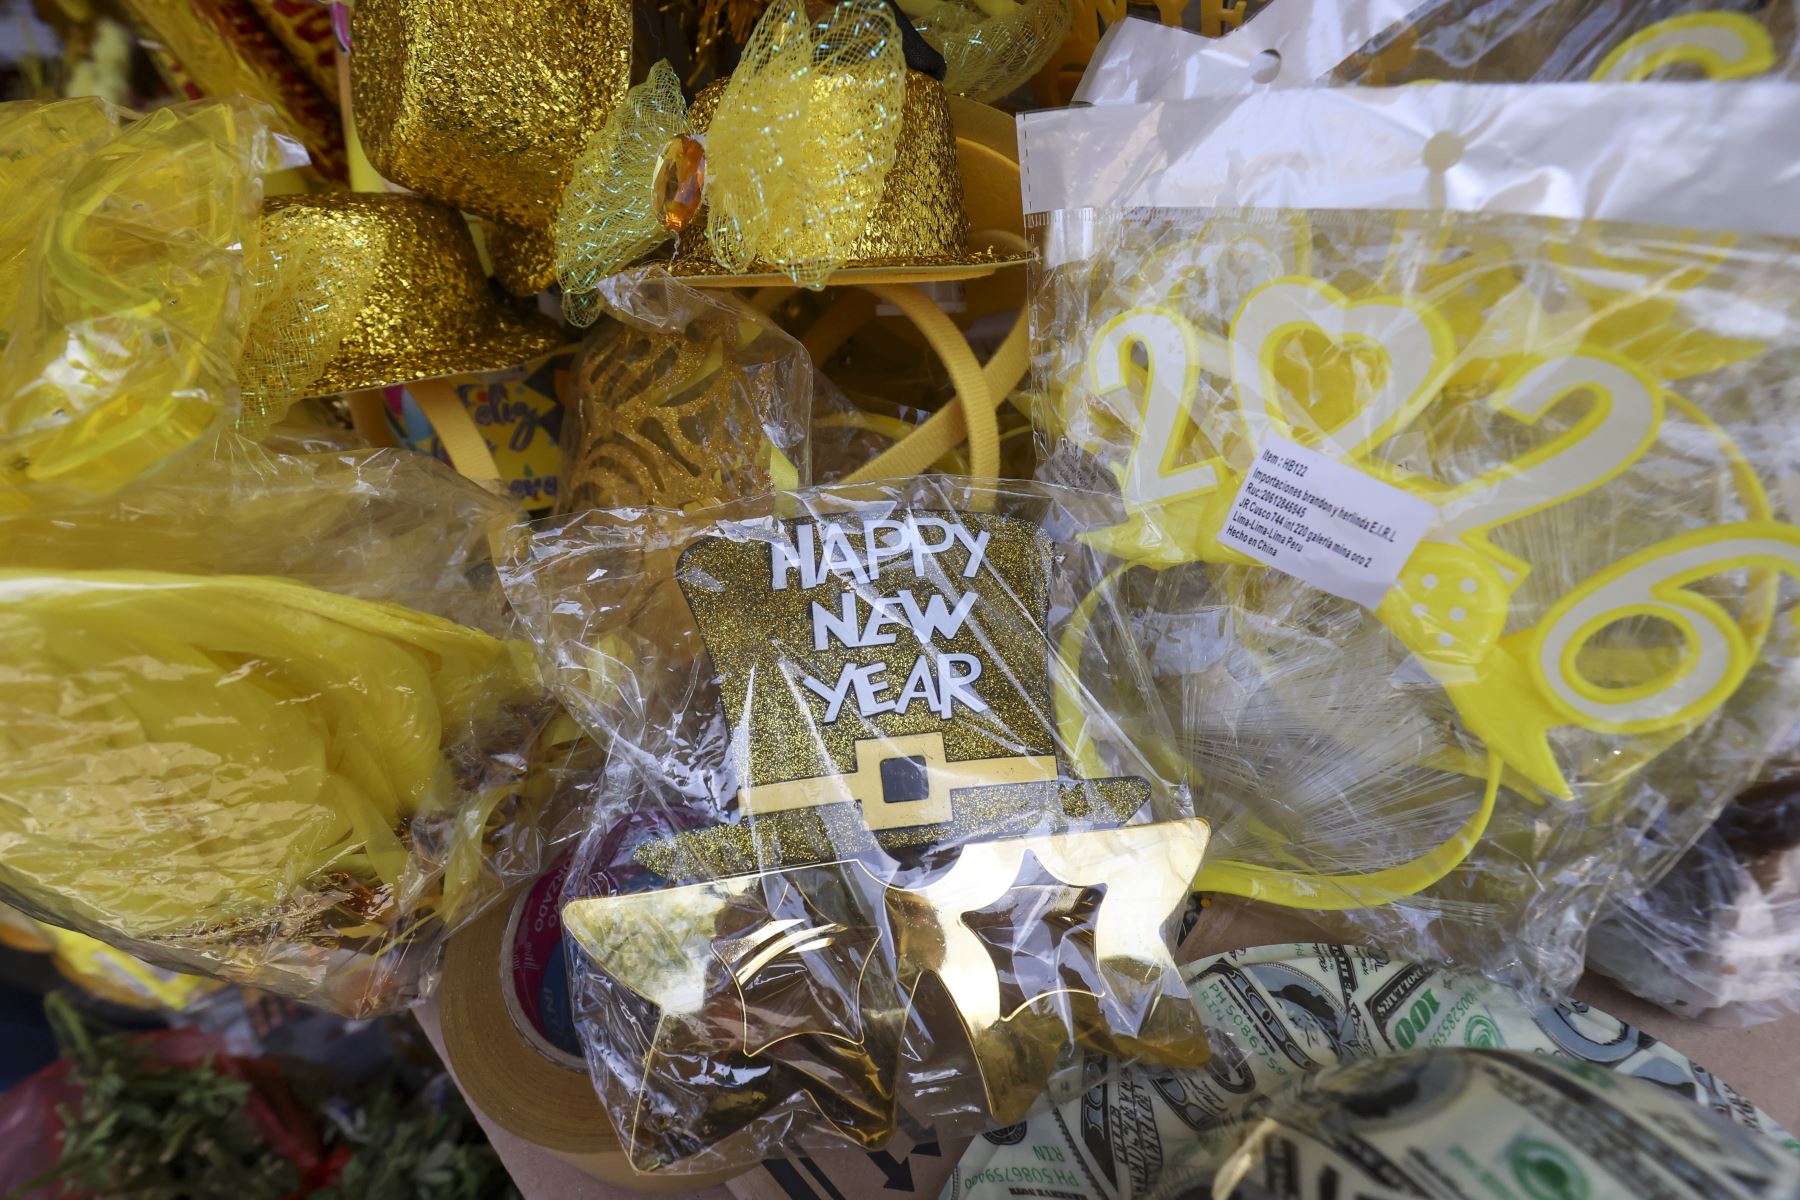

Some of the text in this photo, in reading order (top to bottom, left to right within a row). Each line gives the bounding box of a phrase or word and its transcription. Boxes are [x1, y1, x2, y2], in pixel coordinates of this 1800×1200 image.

[1262, 449, 1280, 466] Item
[1281, 457, 1308, 478] HB122
[1252, 467, 1303, 500] Importaciones
[1301, 492, 1333, 514] brandon
[772, 517, 990, 590] HAPPY
[1226, 525, 1249, 544] Hecho
[1257, 539, 1279, 557] China
[1232, 511, 1304, 553] Lima-Lima-Lima Peru
[1239, 498, 1251, 510] JR
[1249, 501, 1271, 521] Cusco
[1271, 511, 1284, 526] 744
[1283, 517, 1295, 530] int
[1293, 521, 1309, 537] 220
[1332, 540, 1352, 558] mina
[1351, 551, 1366, 567] oro
[1363, 557, 1373, 568] 2
[811, 589, 979, 651] NEW
[802, 653, 988, 724] YEAR
[1198, 990, 1224, 1021] RIN
[1376, 967, 1425, 1016] DOLLARS
[1395, 987, 1443, 1052] 100
